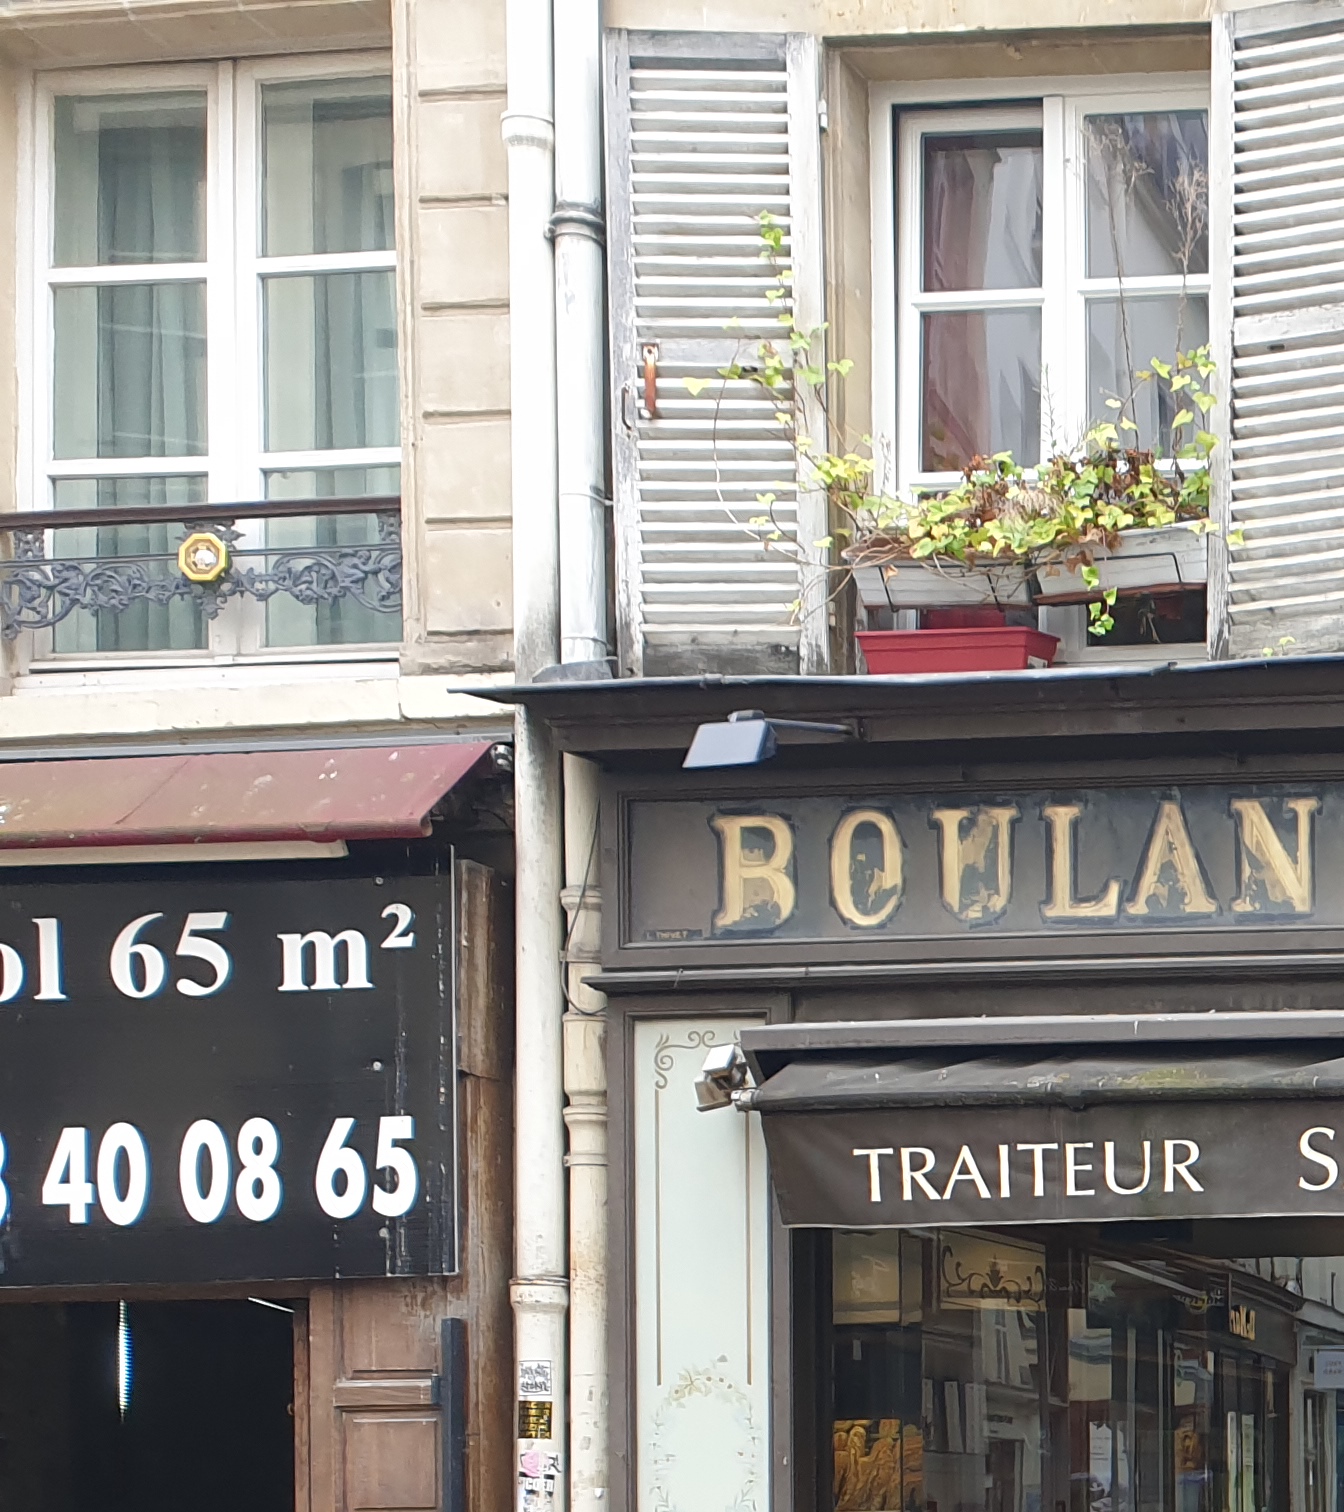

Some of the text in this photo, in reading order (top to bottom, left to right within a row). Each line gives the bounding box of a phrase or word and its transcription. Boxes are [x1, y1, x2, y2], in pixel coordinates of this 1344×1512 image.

[109, 911, 231, 998] 65
[42, 1122, 148, 1225] 40
[180, 1118, 283, 1222] 08
[315, 1115, 419, 1218] 65
[853, 1139, 1204, 1202] TRAITEUR
